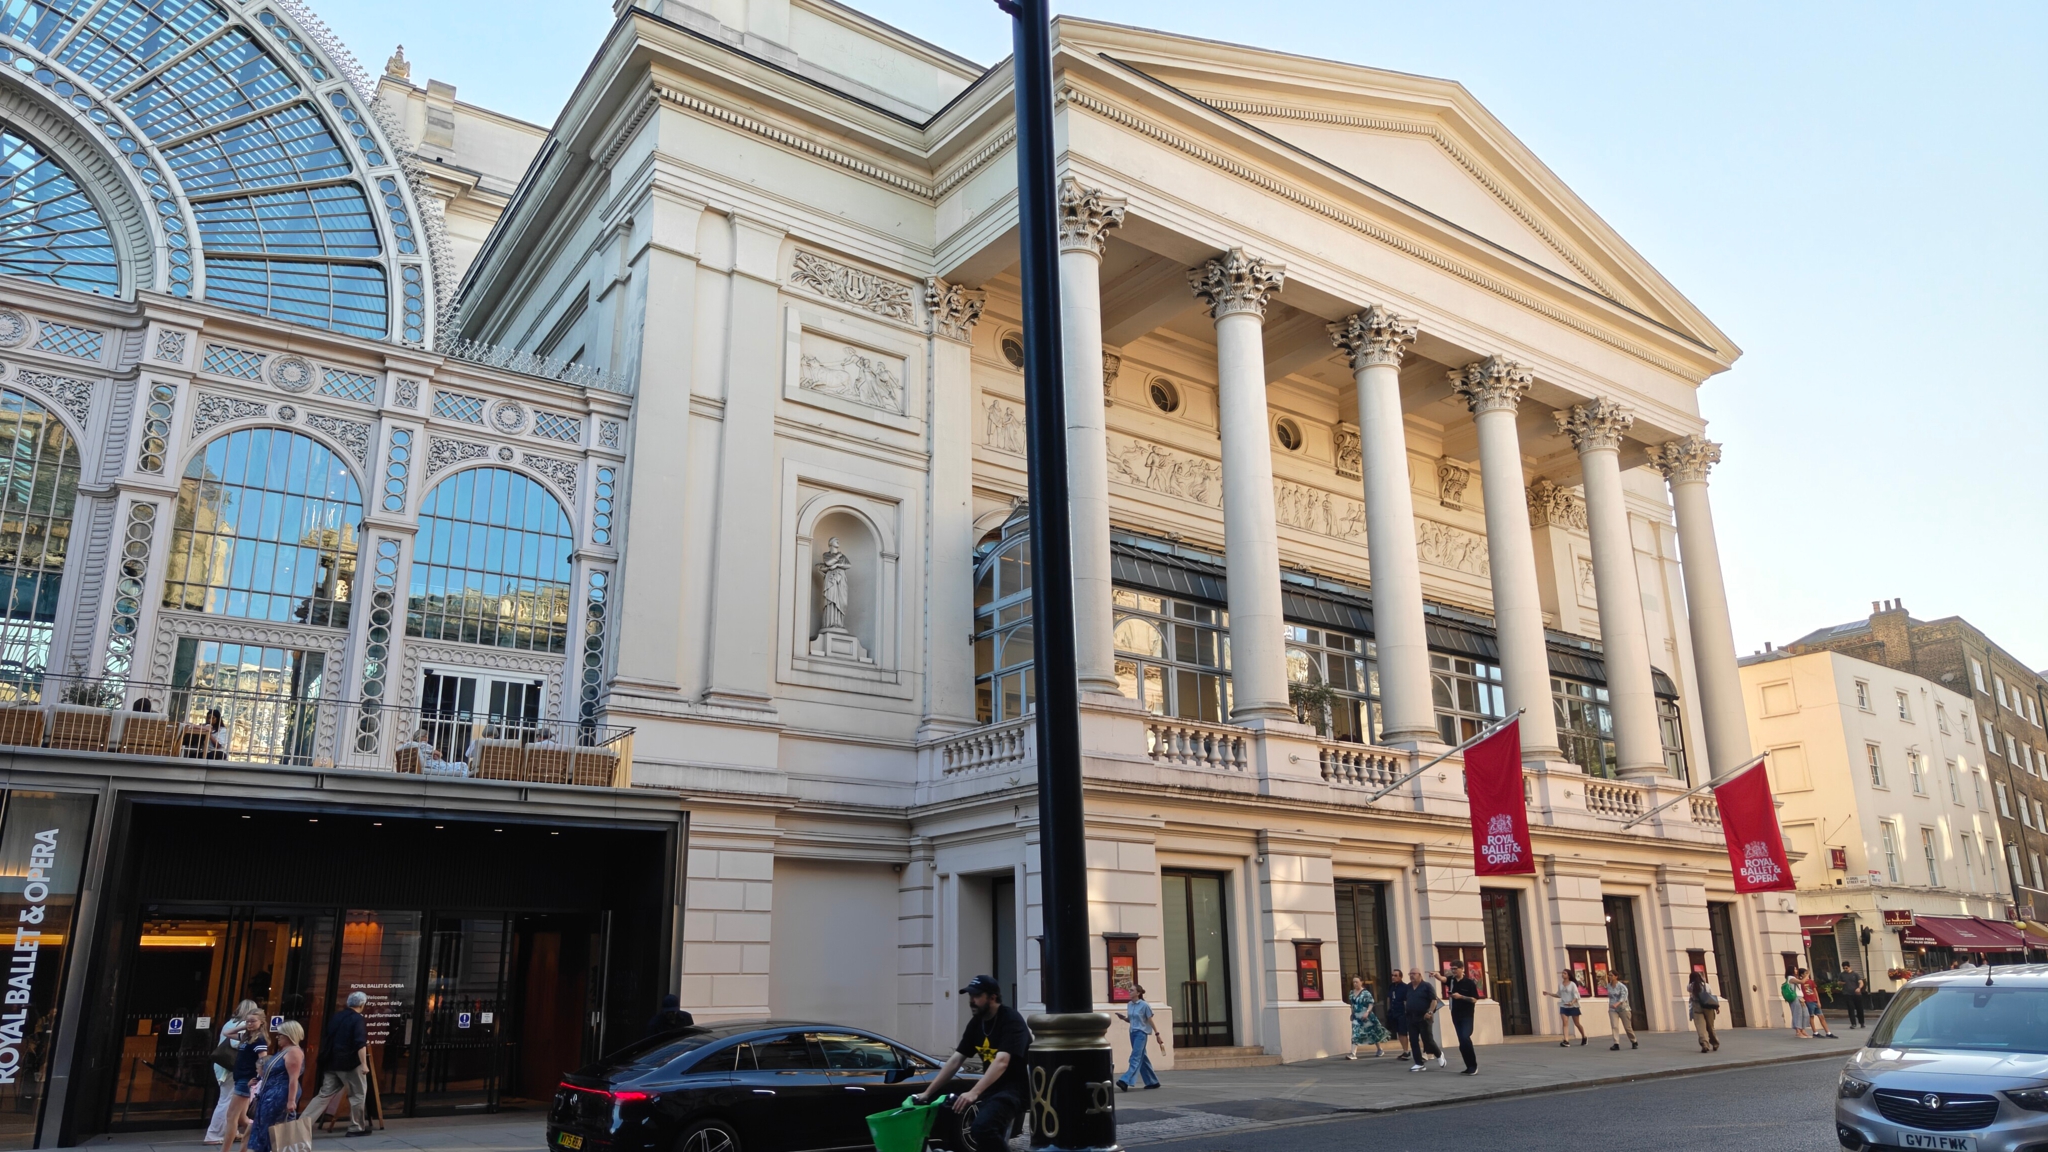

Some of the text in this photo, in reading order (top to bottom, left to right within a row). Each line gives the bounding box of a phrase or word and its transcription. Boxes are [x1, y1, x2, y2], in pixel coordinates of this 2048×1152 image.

[1488, 834, 1514, 845] ROYAL
[1482, 843, 1522, 854] BALLET &
[1488, 854, 1518, 864] OPERA
[1745, 858, 1775, 868] ROYAL
[1740, 865, 1782, 876] BALLET &
[1747, 874, 1779, 884] OPERA
[0, 828, 60, 1084] ROYAL BALLET & OPERA
[1906, 1134, 1968, 1151] GV71 FWK
